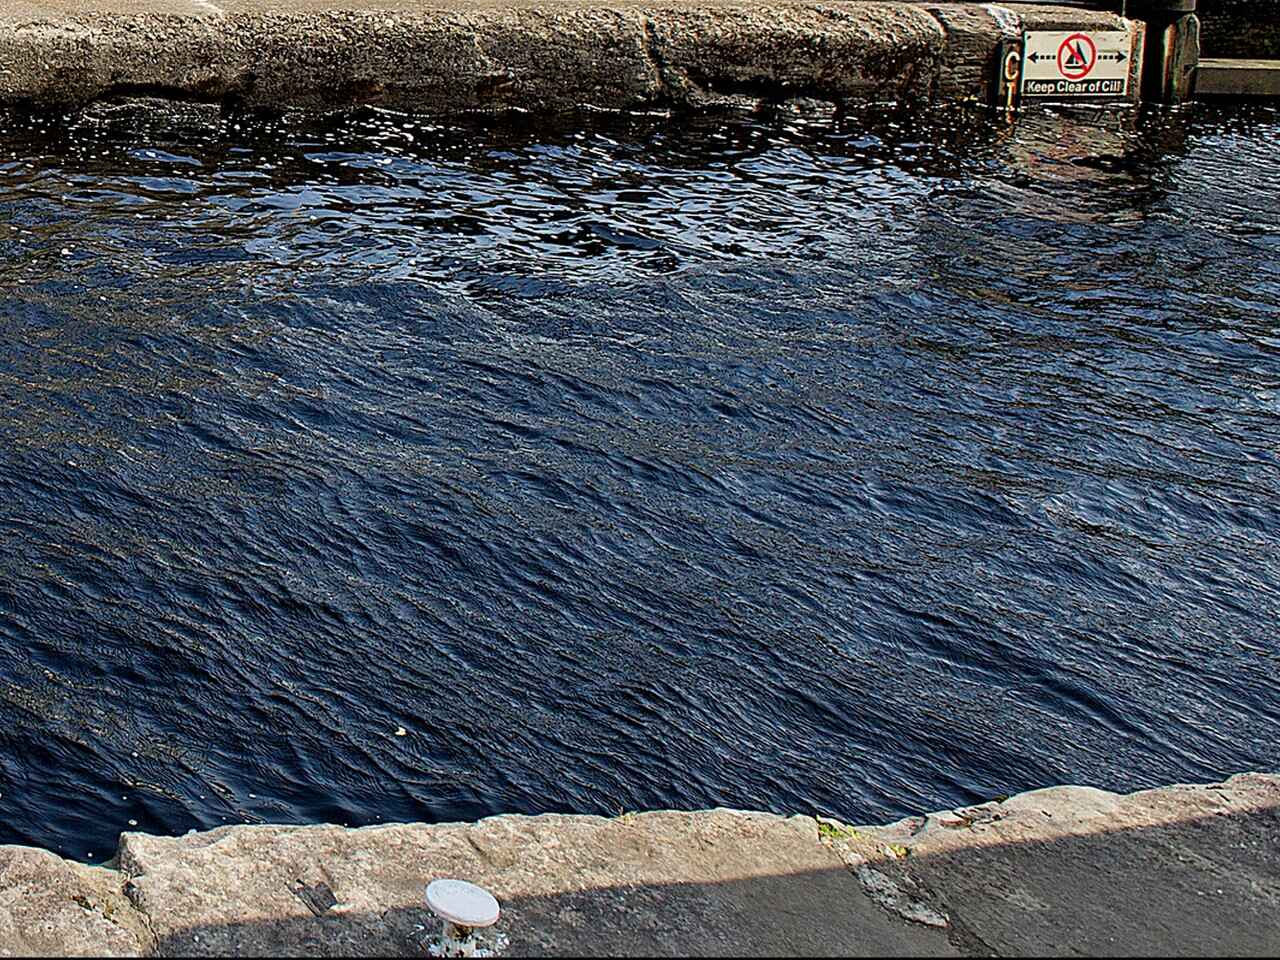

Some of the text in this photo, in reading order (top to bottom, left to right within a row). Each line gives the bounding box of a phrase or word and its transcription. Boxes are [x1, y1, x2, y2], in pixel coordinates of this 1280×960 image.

[1027, 80, 1122, 94] Keep Clear of Cill
